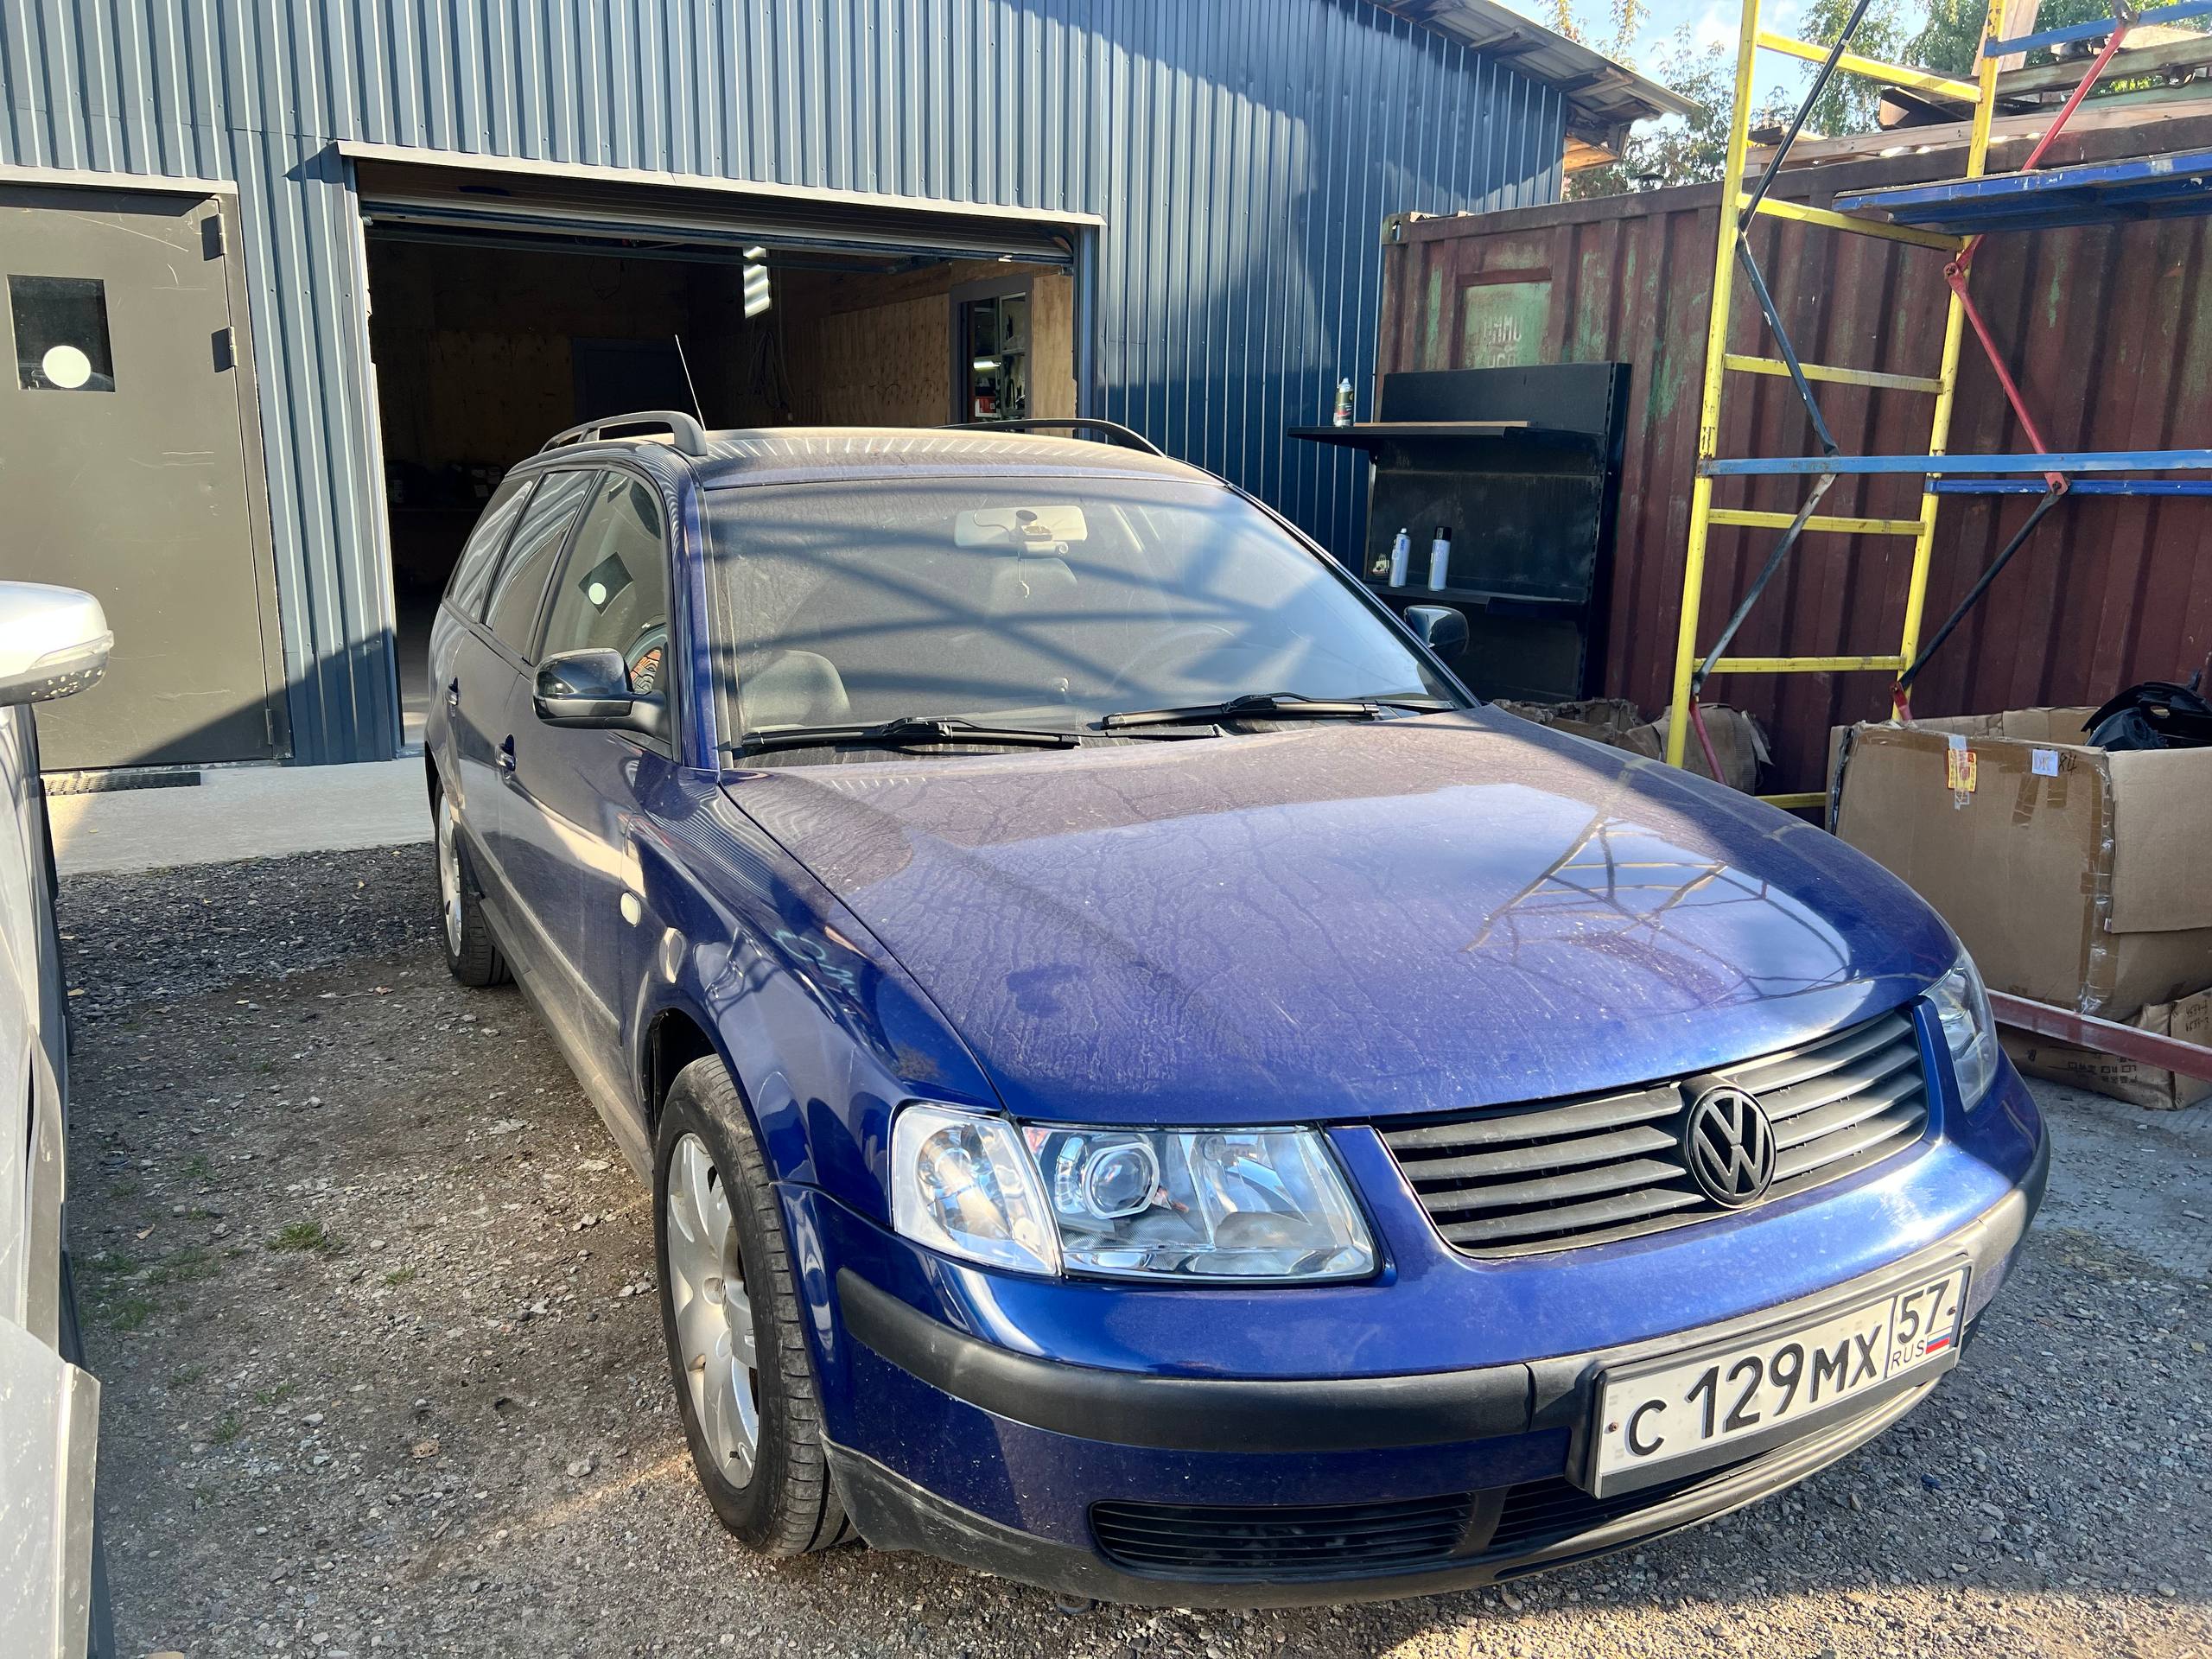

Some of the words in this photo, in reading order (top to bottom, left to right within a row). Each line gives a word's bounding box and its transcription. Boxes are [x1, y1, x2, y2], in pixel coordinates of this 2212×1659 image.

[1690, 1088, 1774, 1205] VW
[1897, 1278, 1950, 1344] 57
[1891, 1339, 1925, 1370] RUS
